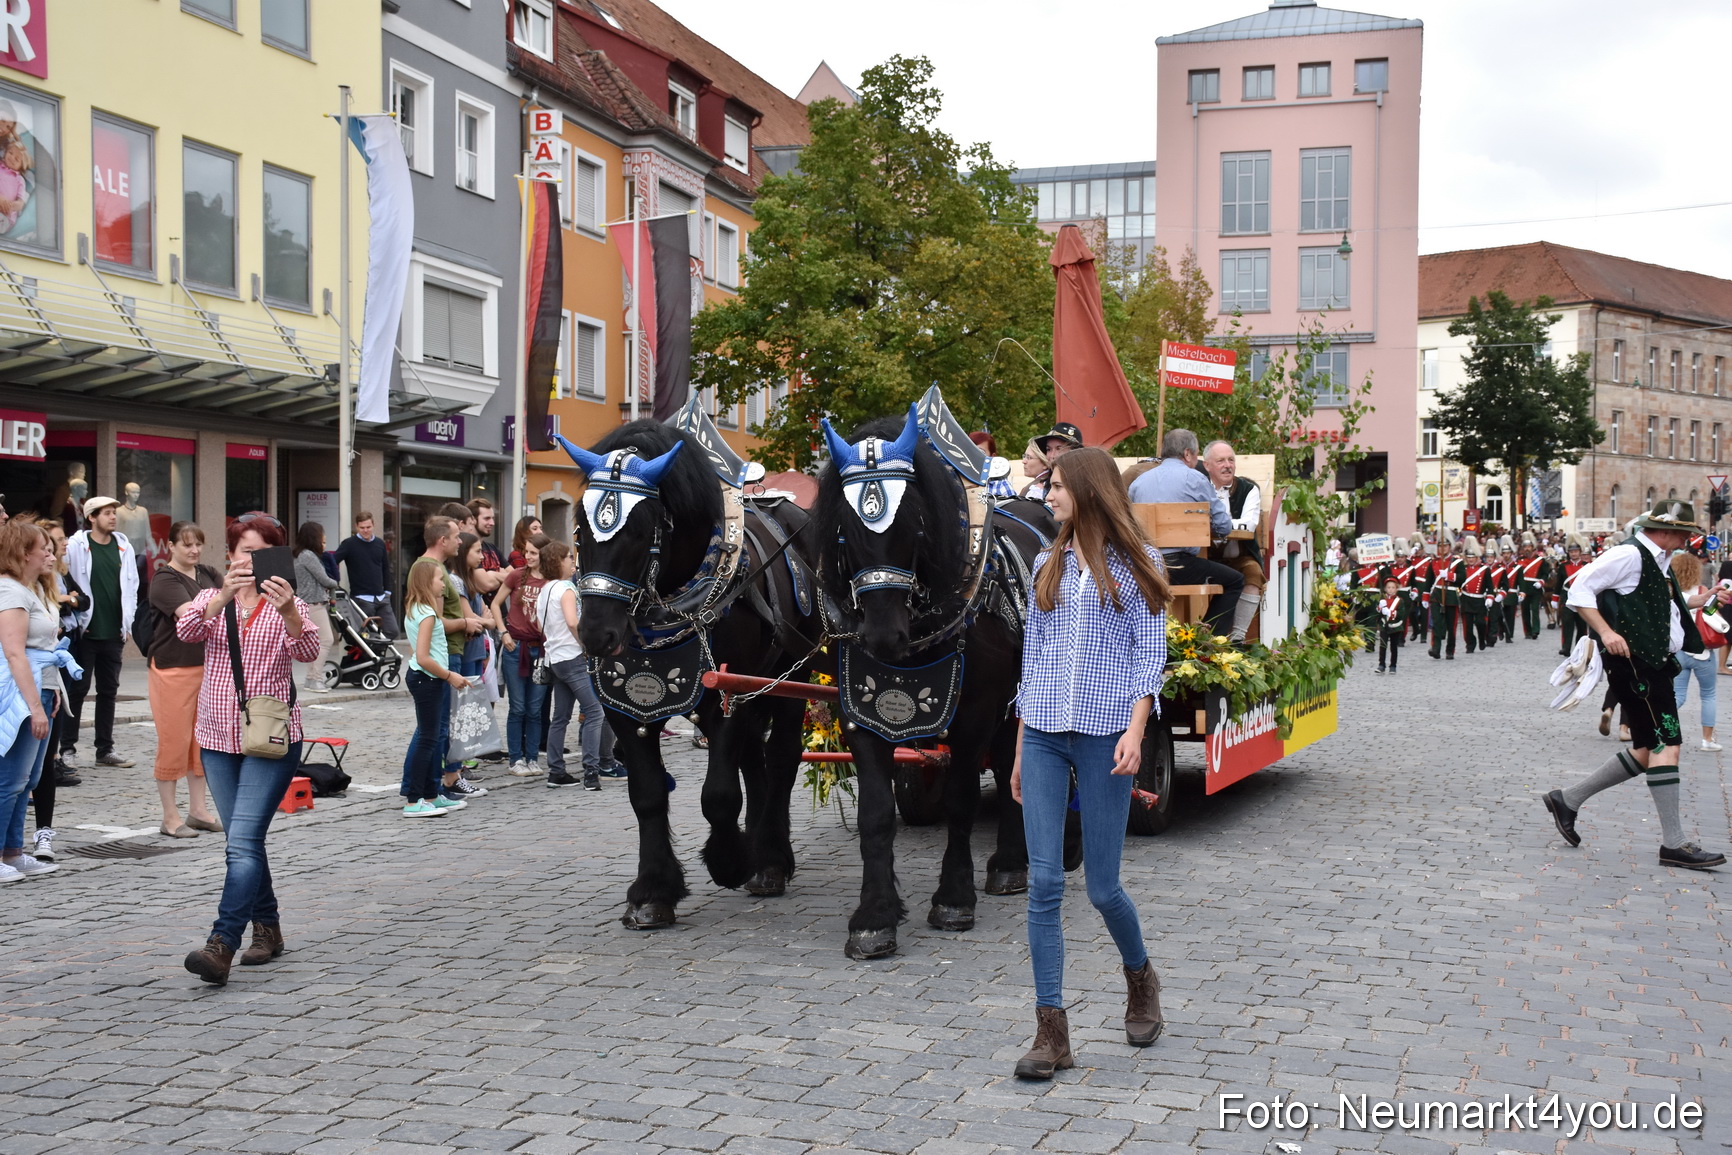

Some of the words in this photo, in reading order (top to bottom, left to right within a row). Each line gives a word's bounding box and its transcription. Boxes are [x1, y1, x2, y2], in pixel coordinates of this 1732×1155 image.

[1168, 344, 1227, 363] Mistelbach
[1165, 372, 1223, 389] Neumarkt
[306, 493, 328, 501] ADLER
